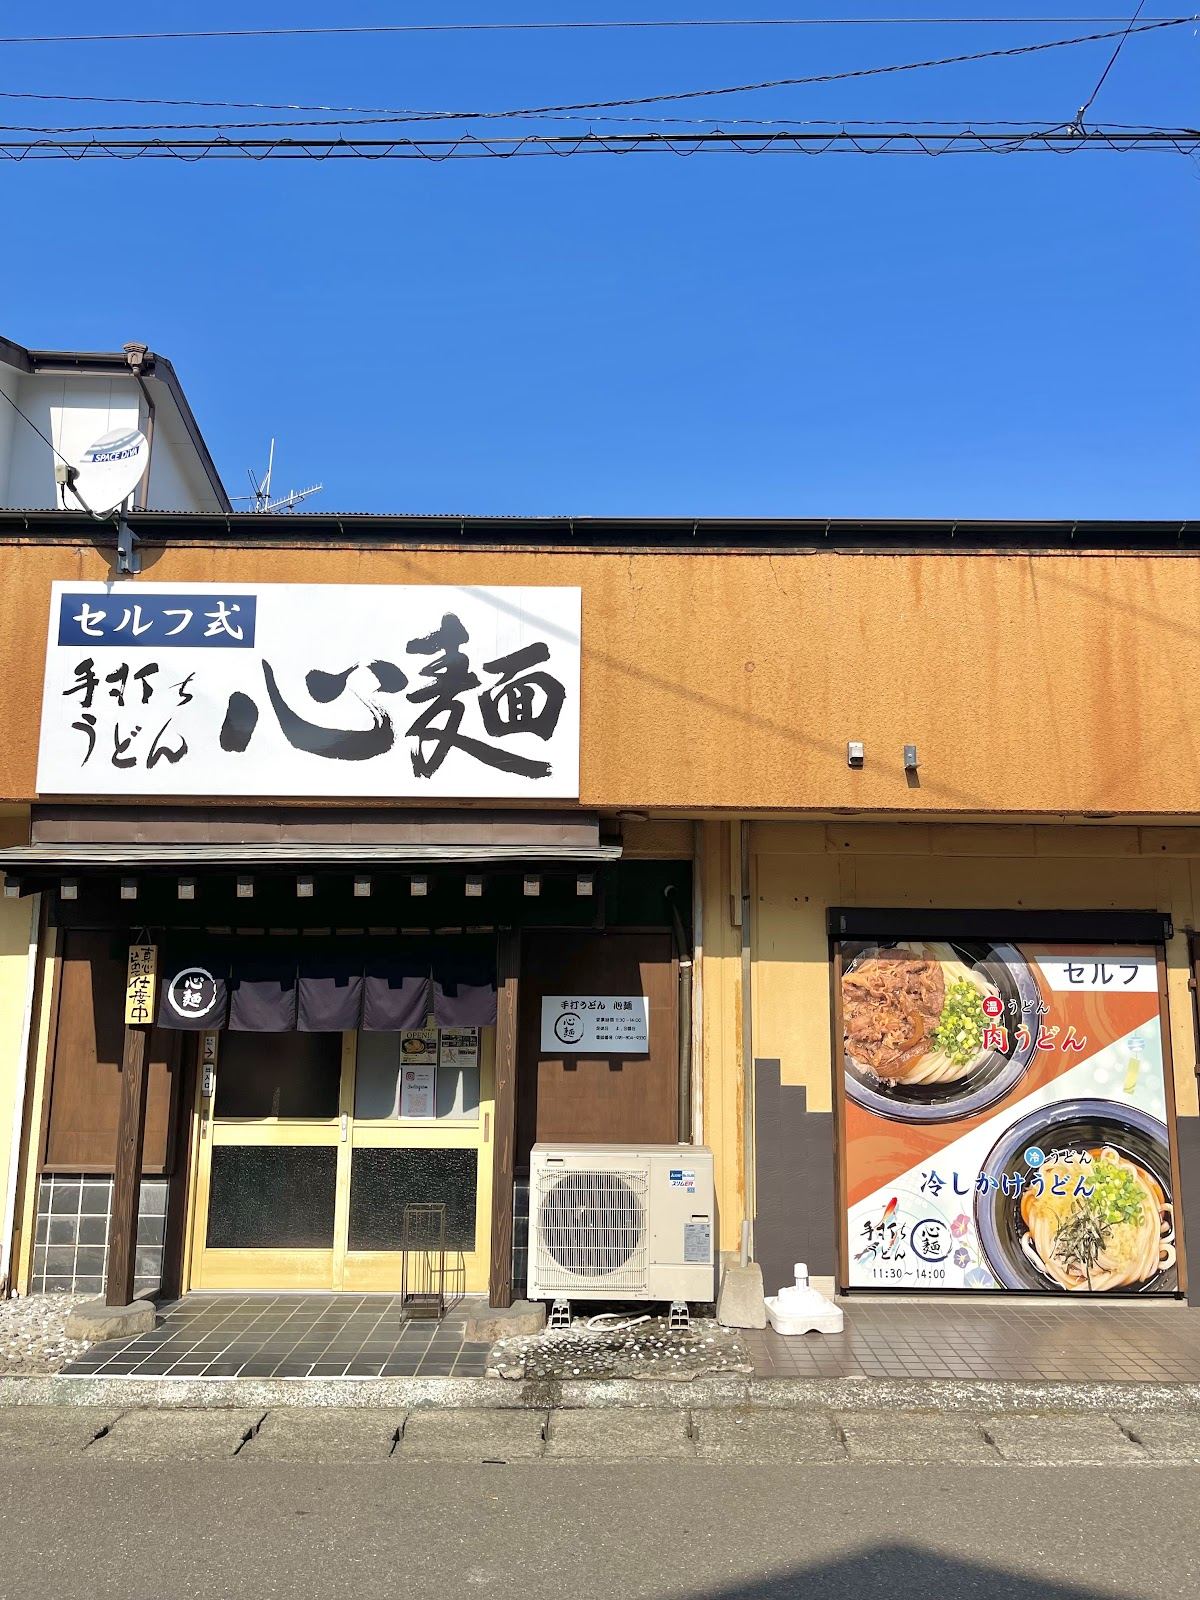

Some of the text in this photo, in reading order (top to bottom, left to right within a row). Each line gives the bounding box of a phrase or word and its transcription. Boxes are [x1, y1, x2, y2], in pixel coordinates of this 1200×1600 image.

[95, 452, 120, 462] SPACE
[72, 601, 245, 641] セルフ式
[62, 657, 197, 708] 手打ち
[219, 612, 567, 779] 心麺
[71, 713, 189, 768] うどん
[140, 947, 154, 974] 真心
[1062, 962, 1140, 986] セルフ
[128, 976, 151, 1022] 仕度中
[183, 976, 205, 1008] 心麺
[560, 1000, 606, 1010] 手打うどん
[1008, 999, 1050, 1015] うどん
[982, 1023, 1087, 1053] 肉うどん
[1050, 1149, 1093, 1165] うどん
[920, 1170, 1096, 1199] 冷しかけうどん
[860, 1220, 907, 1241] 手打ち
[921, 1226, 943, 1255] 心麺
[868, 1243, 906, 1262] うどん
